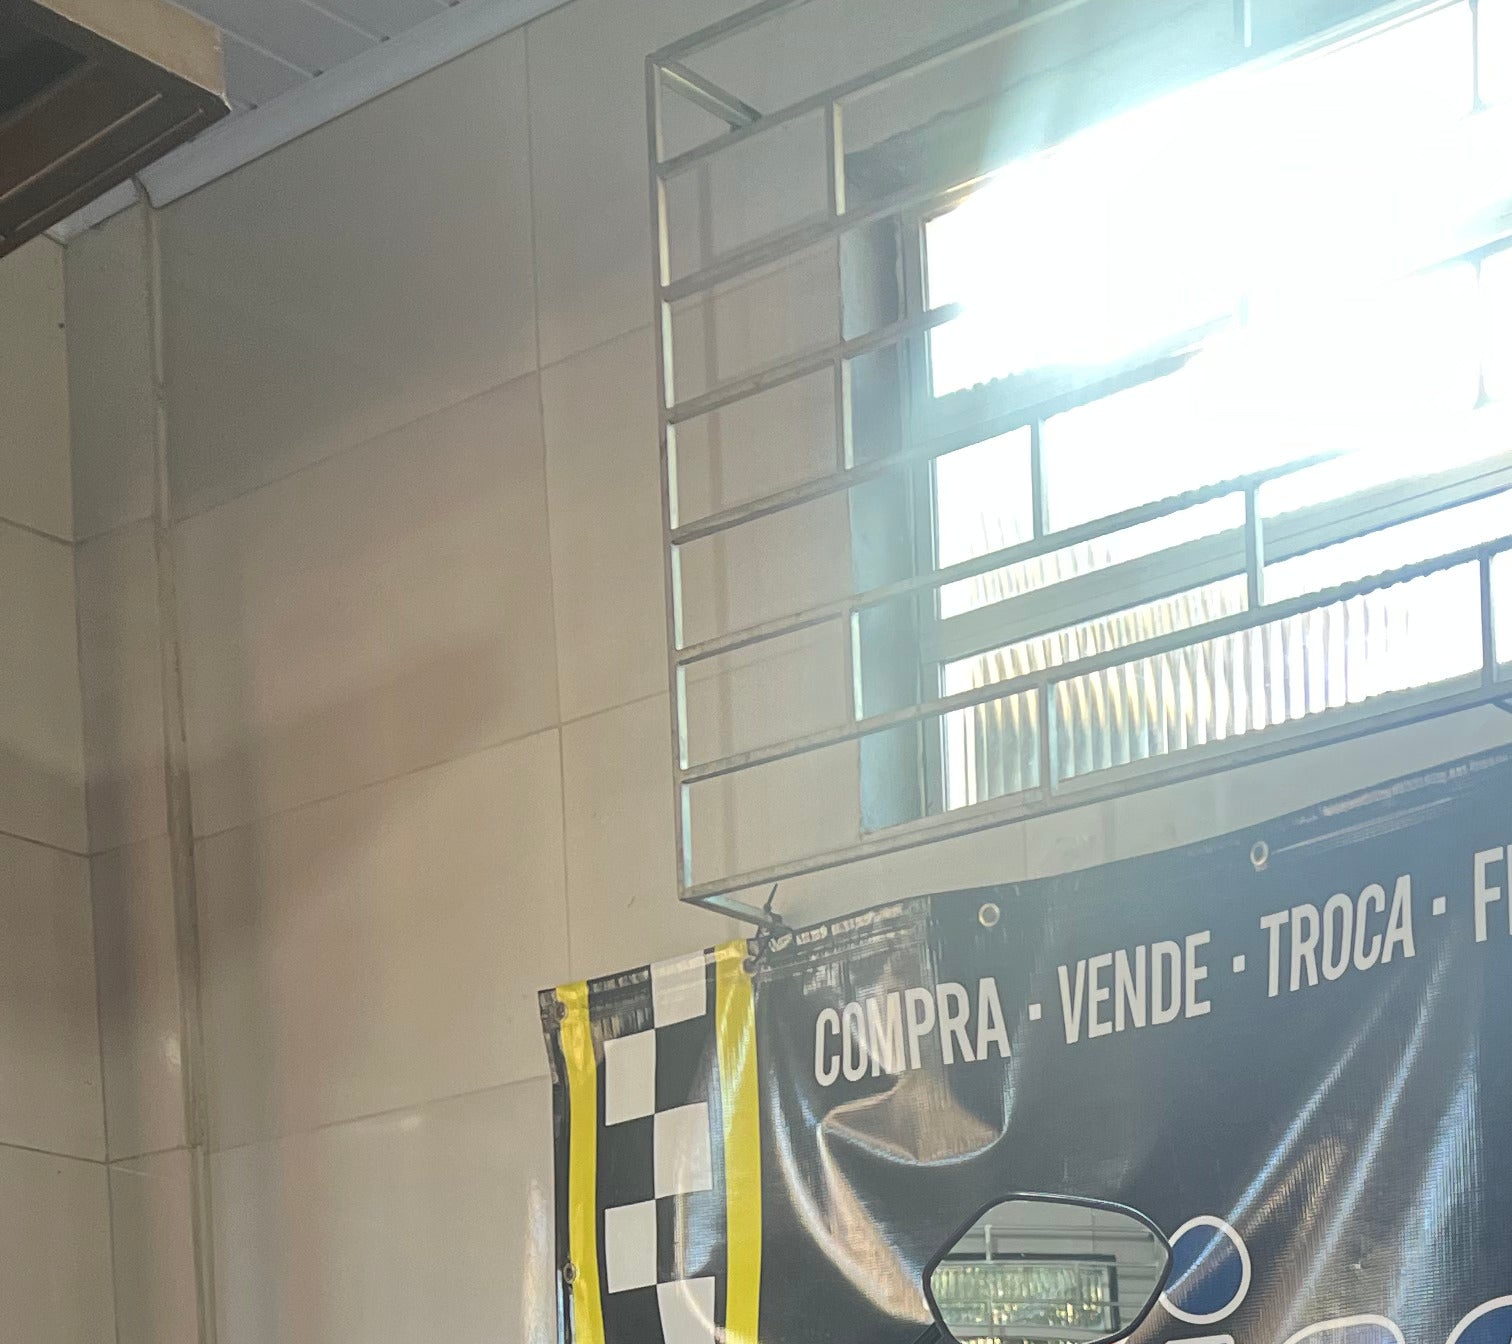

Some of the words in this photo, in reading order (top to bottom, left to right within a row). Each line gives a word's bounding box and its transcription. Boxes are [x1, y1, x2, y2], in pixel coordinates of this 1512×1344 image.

[813, 976, 1011, 1087] COMPRA
[1057, 929, 1212, 1045] VENDE
[1259, 873, 1417, 999] TROCA
